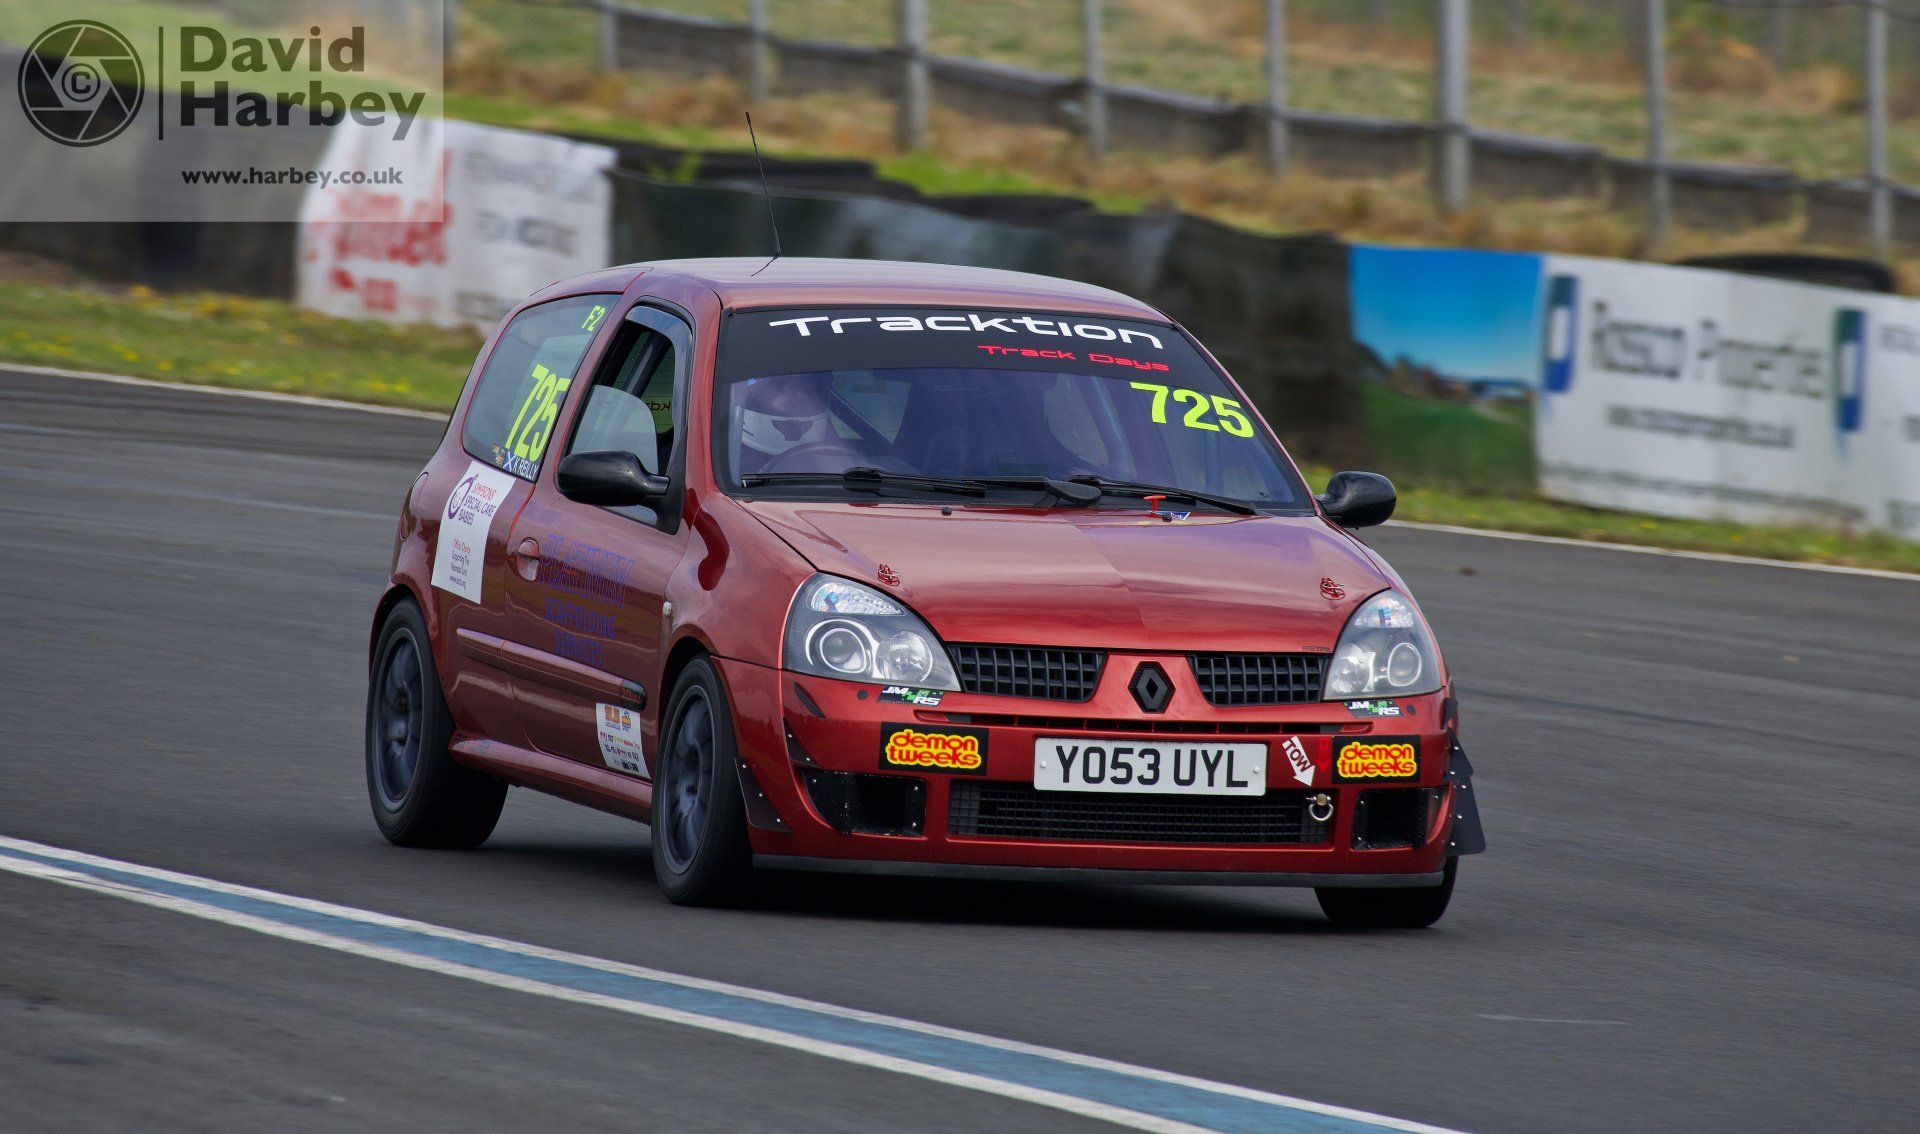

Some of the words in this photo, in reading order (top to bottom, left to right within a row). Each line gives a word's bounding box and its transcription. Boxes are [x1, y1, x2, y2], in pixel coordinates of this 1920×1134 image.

[581, 305, 606, 332] F2
[769, 313, 1164, 350] Tracktion
[977, 344, 1077, 361] Track
[1088, 352, 1170, 373] Days
[505, 363, 572, 462] 725
[1129, 381, 1255, 439] 725
[912, 696, 942, 706] RS
[889, 729, 979, 752] demon
[1340, 741, 1415, 762] demon
[885, 744, 982, 769] tweeks
[1055, 744, 1161, 787] YO53
[1173, 747, 1249, 789] UYL
[1284, 740, 1312, 773] TOW
[1337, 757, 1418, 778] tweeks
